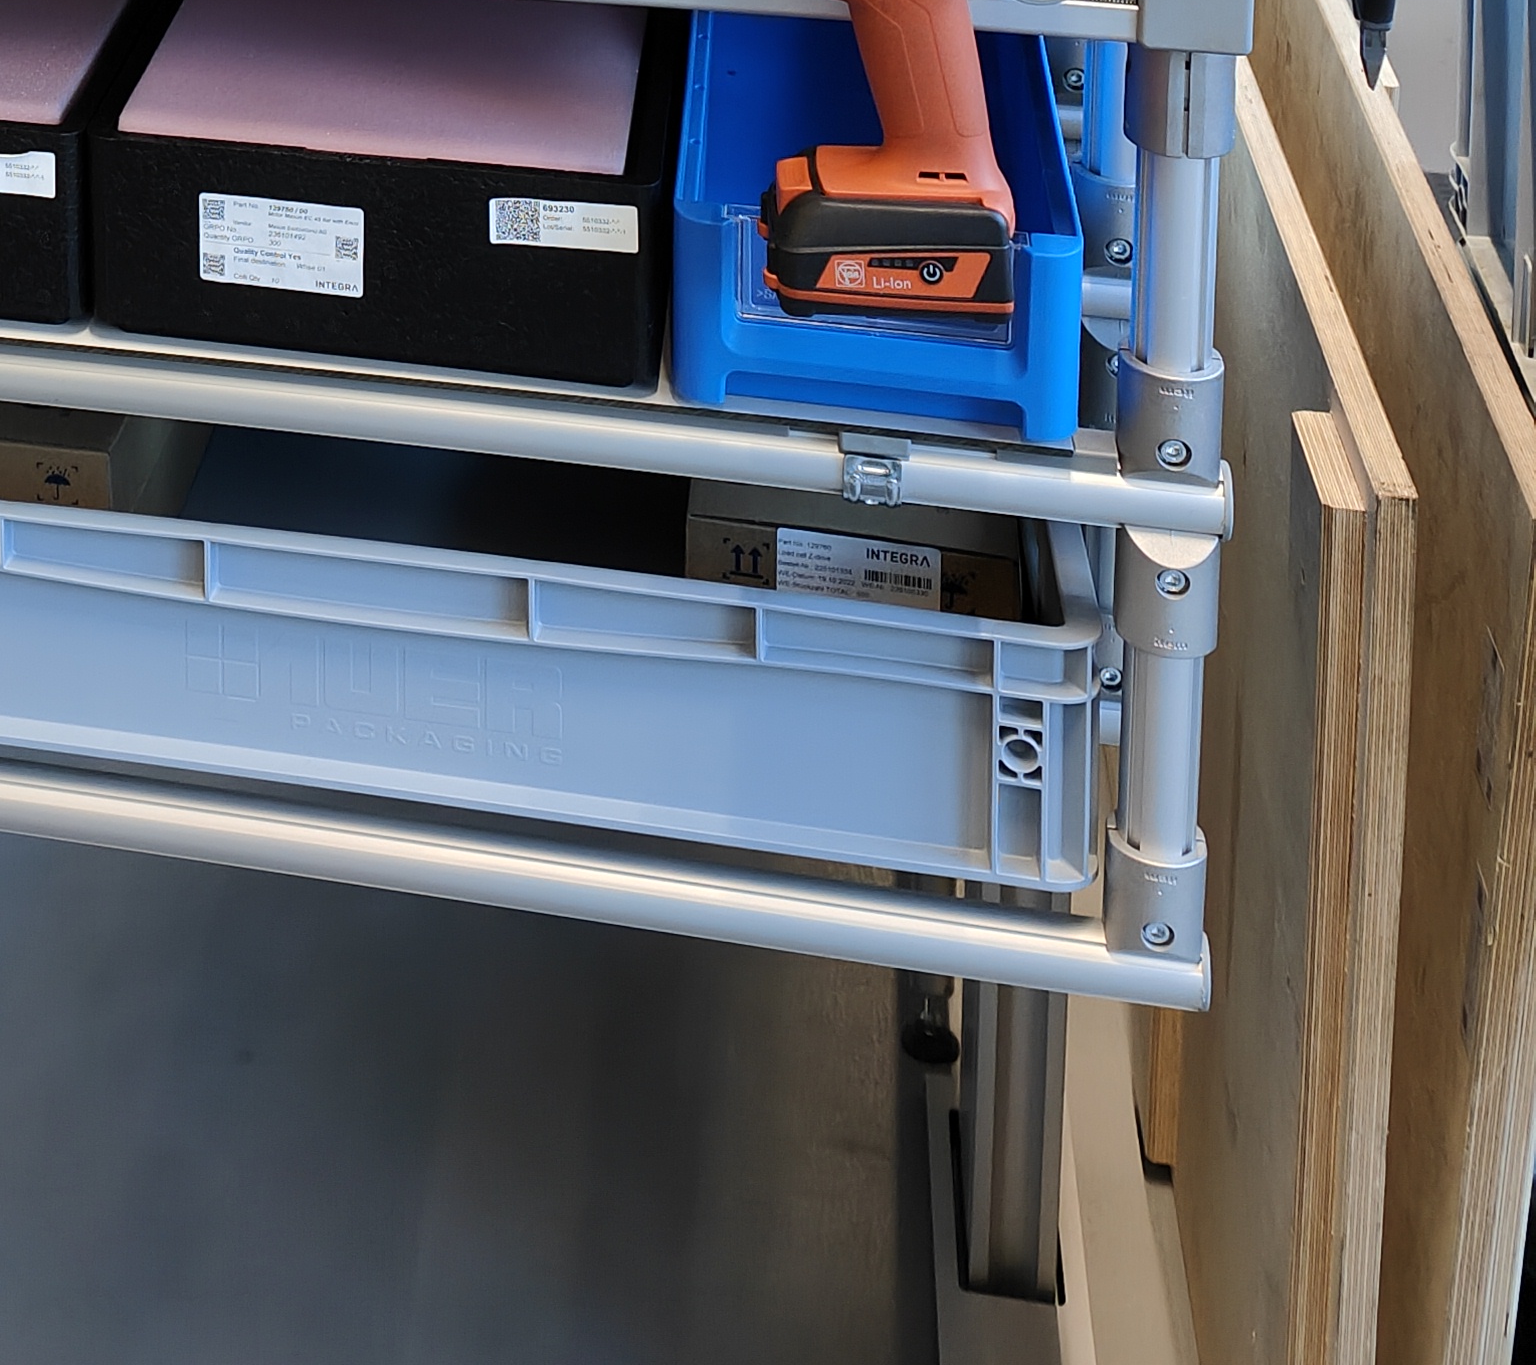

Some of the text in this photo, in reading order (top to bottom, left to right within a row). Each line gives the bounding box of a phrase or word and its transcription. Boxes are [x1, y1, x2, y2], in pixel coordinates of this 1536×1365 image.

[315, 280, 359, 293] INTEGRA
[872, 276, 912, 291] Li-Ion
[866, 548, 931, 568] INTEGRA
[291, 713, 563, 765] PACKAGING
